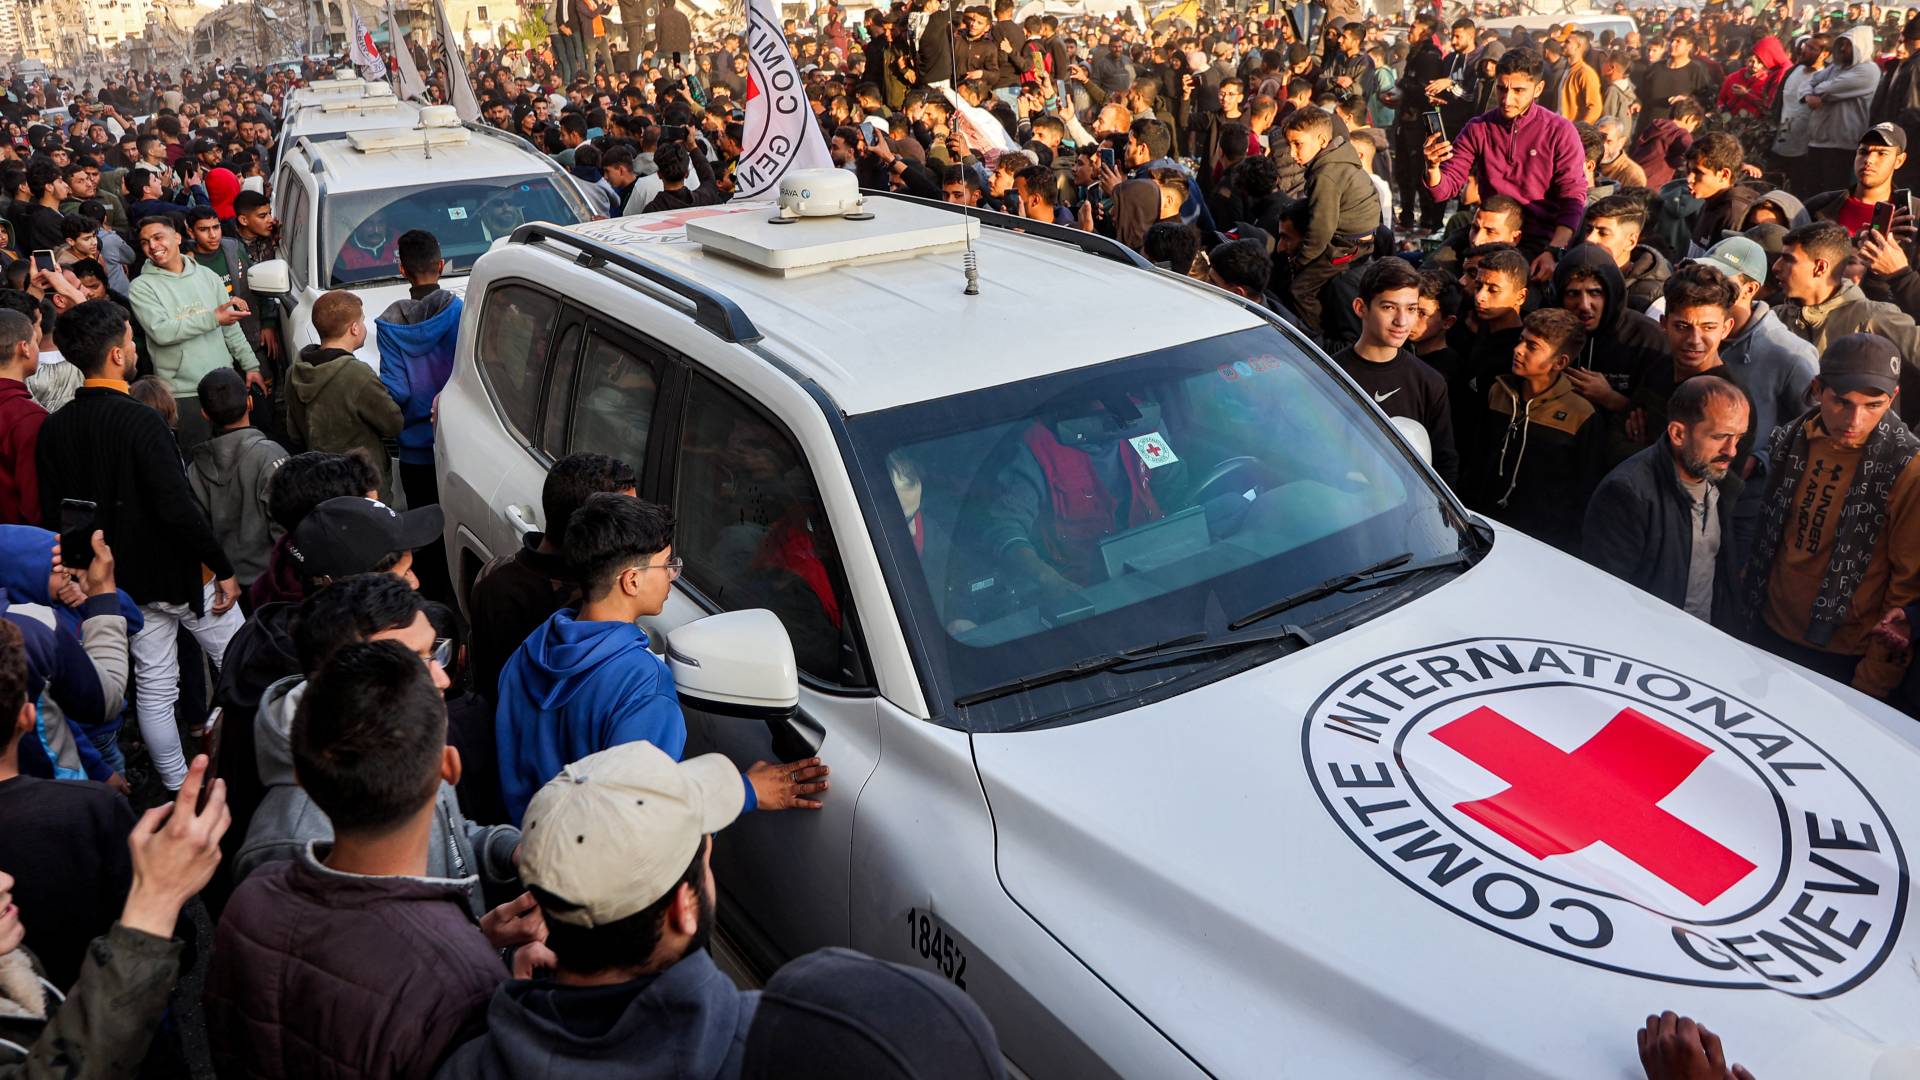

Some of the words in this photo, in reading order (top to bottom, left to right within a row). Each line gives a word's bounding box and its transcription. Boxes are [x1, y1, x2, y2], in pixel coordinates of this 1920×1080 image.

[1795, 479, 1818, 549] ARMOUR
[1807, 485, 1836, 554] UNDER
[1324, 643, 1826, 786] INTERNATIONAL
[1328, 760, 1613, 949] COMITE
[1671, 811, 1881, 985] GENEVE
[908, 907, 966, 992] 18452
